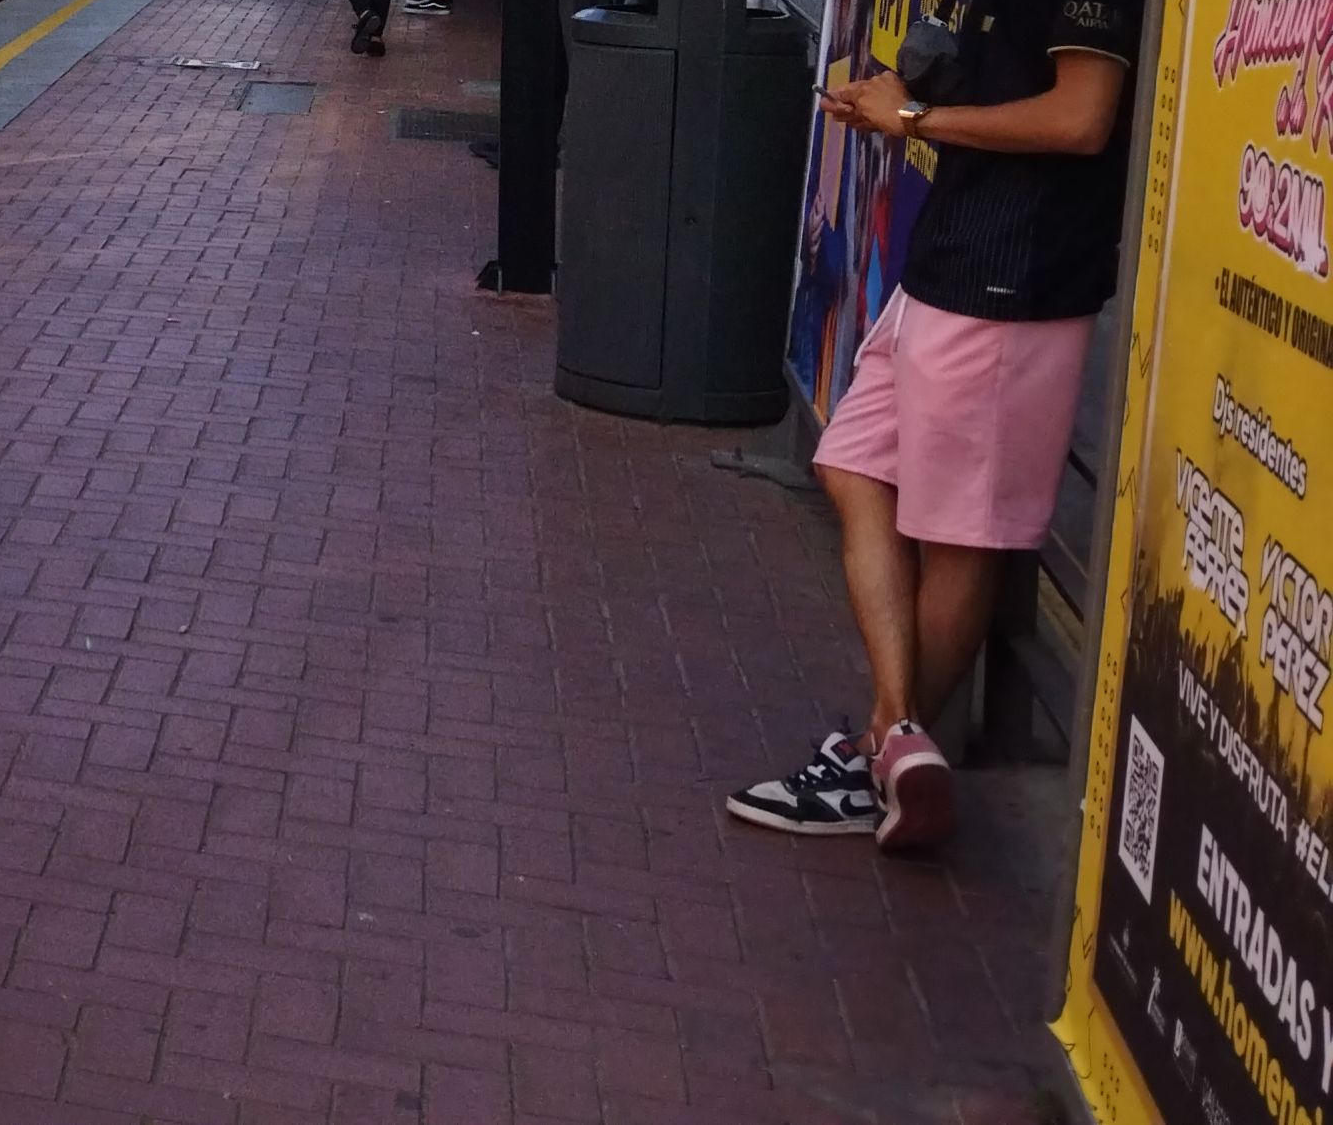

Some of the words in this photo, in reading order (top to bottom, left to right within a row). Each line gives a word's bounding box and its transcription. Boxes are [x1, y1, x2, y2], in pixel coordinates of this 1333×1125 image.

[1229, 271, 1283, 338] AUTÉNTICO
[1283, 300, 1292, 342] Y
[1234, 397, 1308, 500] residentes
[1259, 604, 1332, 735] PEREZ
[1179, 659, 1208, 730] VIVE
[1209, 698, 1220, 742] Y
[1218, 714, 1288, 844] DISFRUTA
[1295, 818, 1333, 903] #EL
[1169, 887, 1324, 1125] www.homen
[1197, 824, 1316, 1061] ENTRADAS
